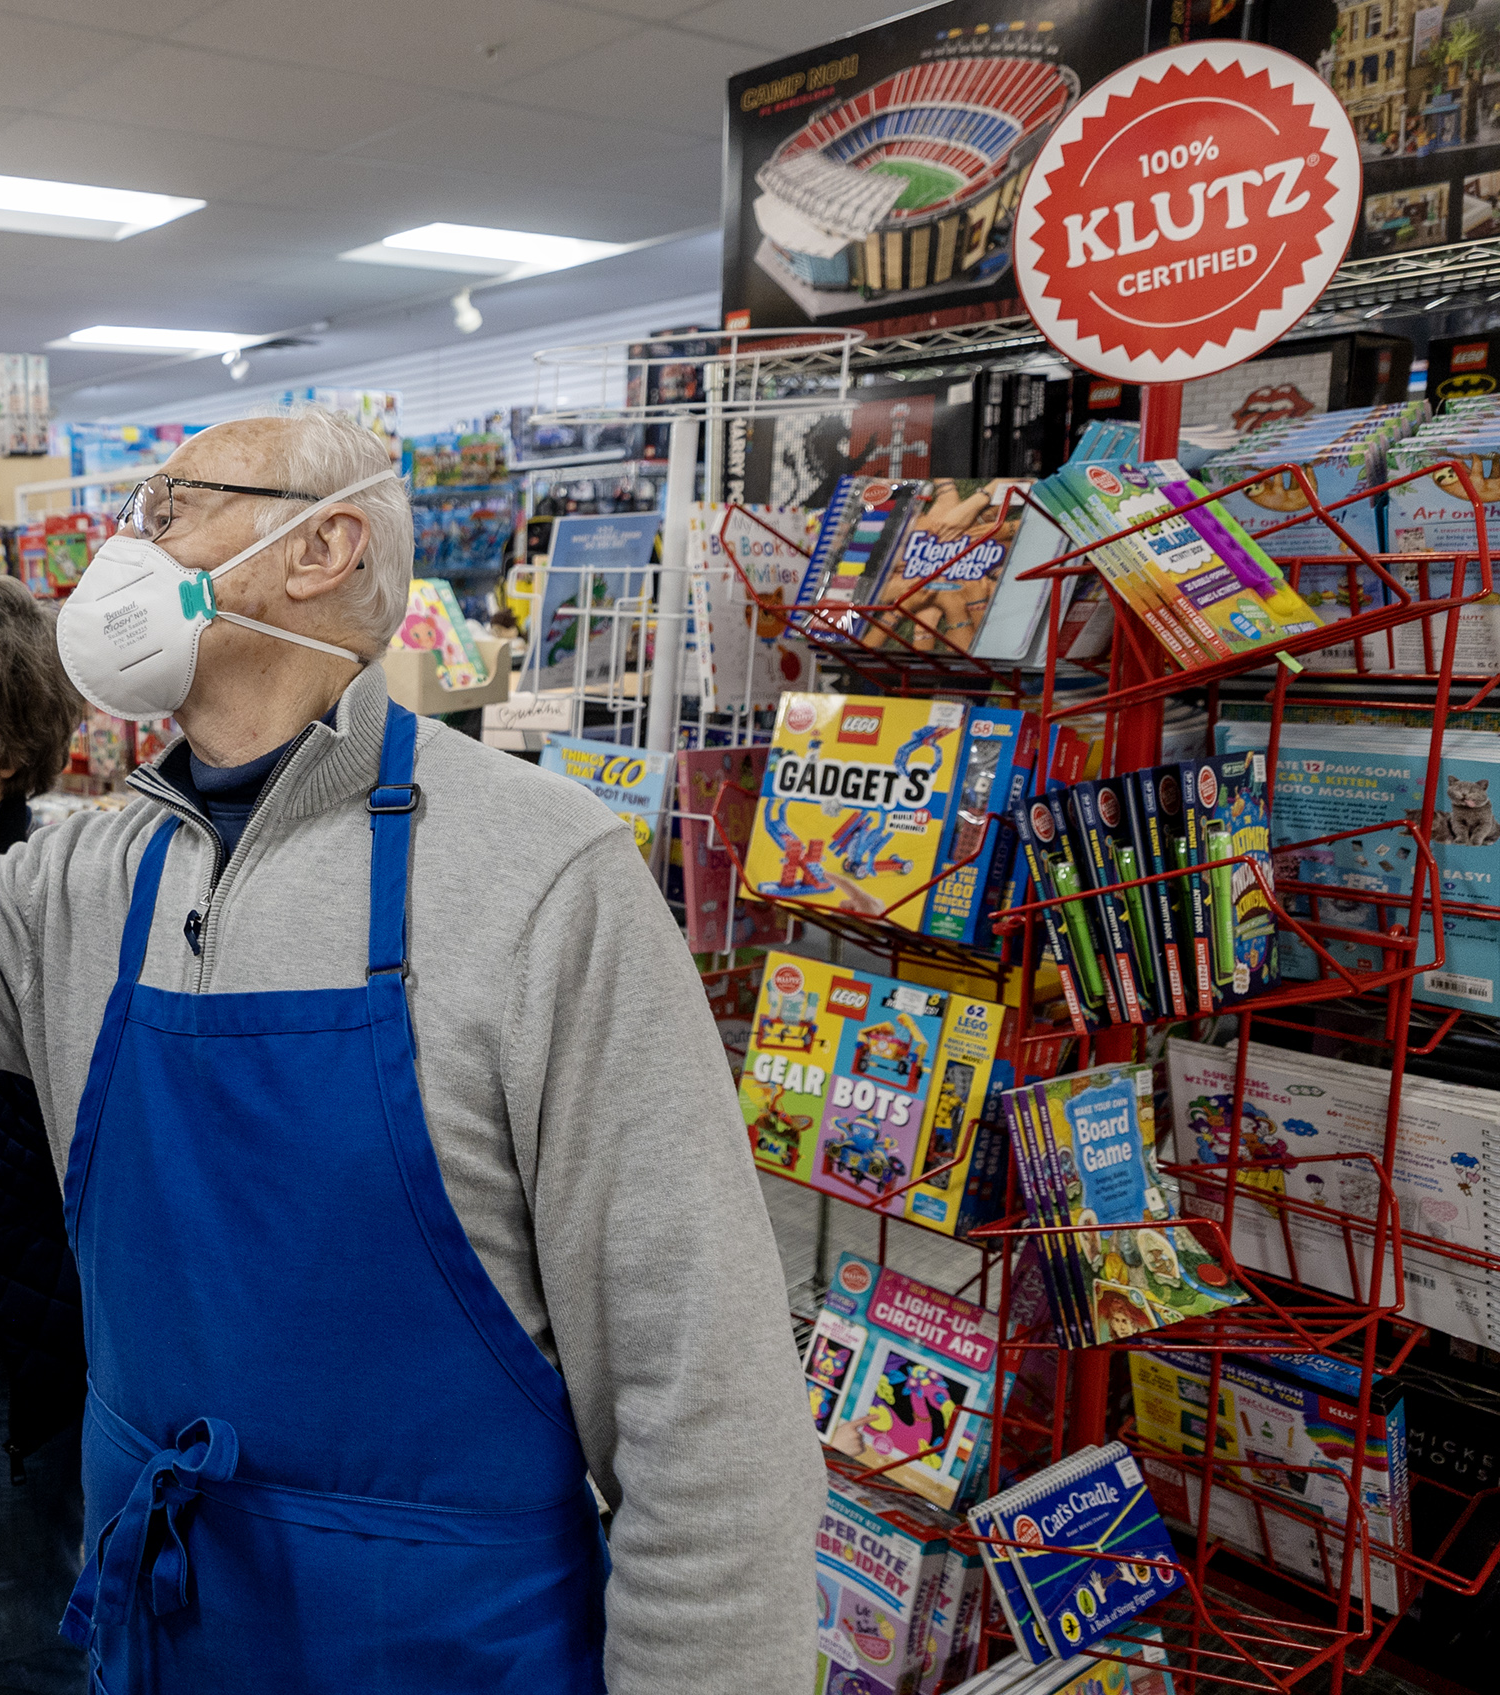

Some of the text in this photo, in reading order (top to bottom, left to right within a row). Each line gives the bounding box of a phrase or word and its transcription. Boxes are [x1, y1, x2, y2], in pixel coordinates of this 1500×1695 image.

[740, 54, 859, 111] CAMP NOU
[1138, 135, 1219, 178] 100%
[1117, 243, 1258, 297] CERTIFIED
[1453, 350, 1486, 365] LEGO
[1090, 386, 1118, 399] LEGO
[1412, 506, 1475, 520] Art on
[741, 536, 784, 557] Book
[842, 716, 881, 735] LEGO
[972, 721, 992, 735] 58
[561, 747, 605, 767] THINGS
[565, 756, 648, 788] THAT GO
[1279, 771, 1378, 788] CAT & KITTEN
[1305, 762, 1411, 779] 12 PAW-SOME
[779, 760, 931, 804] GADGETS
[621, 788, 651, 807] FUN!
[1318, 785, 1395, 802] MOSAICS!
[915, 810, 930, 823] 11
[1443, 869, 1492, 884] EASY!
[937, 880, 974, 899] LEGO
[1192, 888, 1202, 915] ACTIVITY
[1195, 914, 1203, 933] BOOK
[830, 988, 869, 1008] LEGO
[965, 1004, 985, 1018] 62
[957, 1016, 988, 1032] LEGO
[753, 1053, 825, 1097] GEAR
[1183, 1073, 1219, 1089] WITH
[832, 1076, 913, 1127] BOTS
[1112, 1097, 1129, 1108] OWN
[1076, 1108, 1130, 1145] Board
[1082, 1142, 1132, 1172] Game
[893, 1291, 978, 1337] LIGHT-UP
[874, 1303, 948, 1345] CIRCUIT
[948, 1333, 987, 1362] ART
[1041, 1502, 1075, 1538] Cat's
[1068, 1481, 1120, 1514] Cradle
[864, 1519, 882, 1534] KIT
[860, 1534, 908, 1577] CUTE
[1096, 1612, 1113, 1632] Book
[1115, 1598, 1138, 1620] String
[1132, 1587, 1157, 1610] Figures
